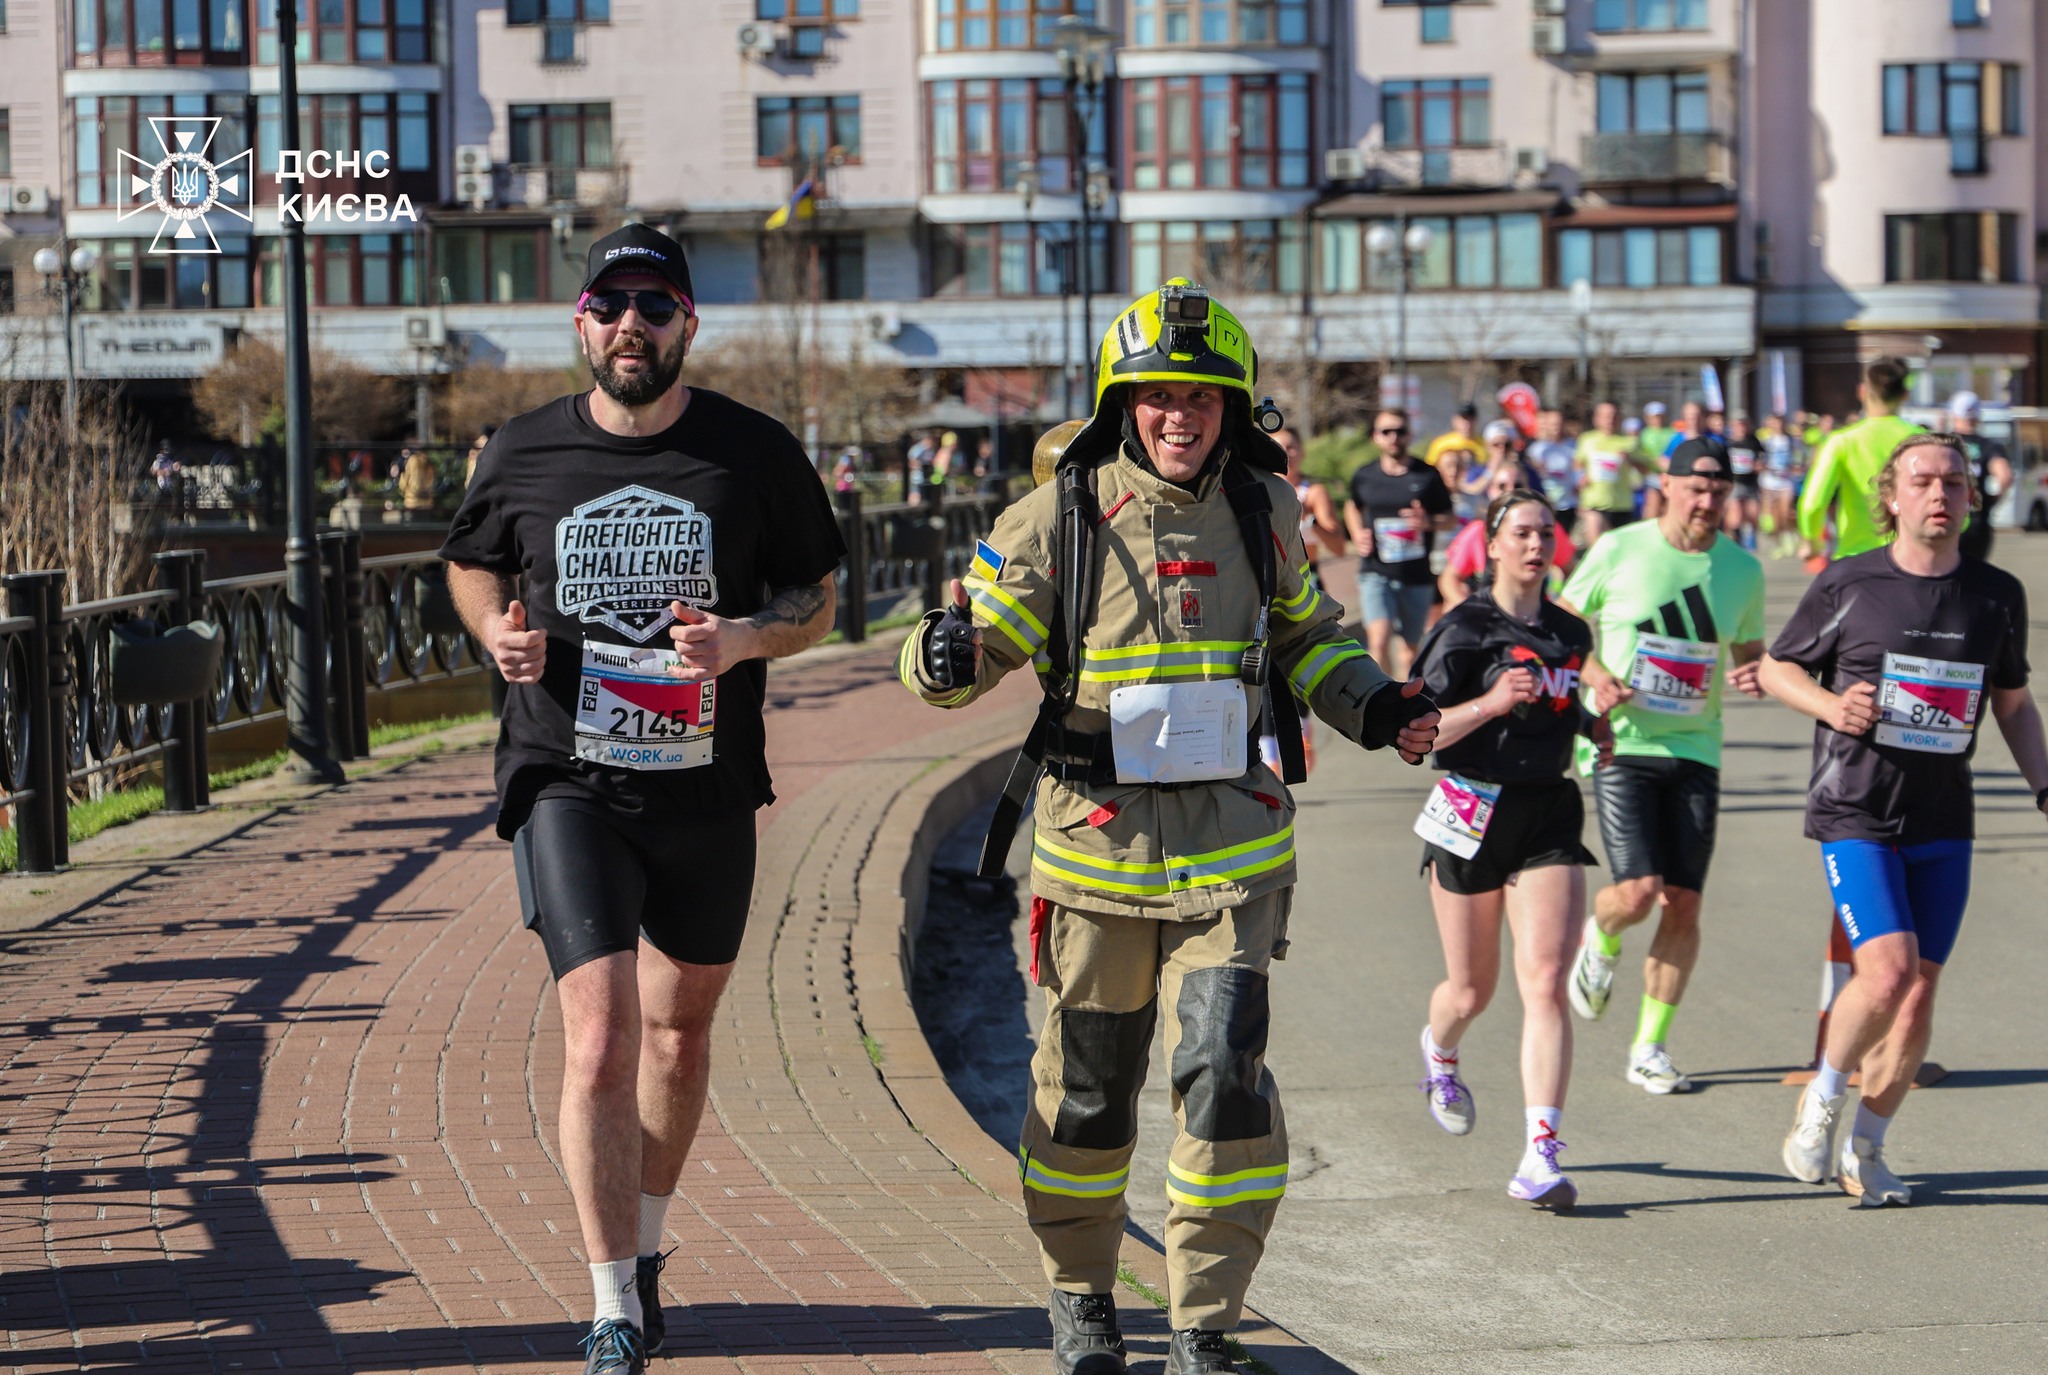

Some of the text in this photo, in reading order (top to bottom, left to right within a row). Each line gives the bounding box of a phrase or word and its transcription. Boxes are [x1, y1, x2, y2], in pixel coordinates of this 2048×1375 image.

[620, 246, 668, 261] Sporter
[1224, 330, 1239, 346] ГУ
[563, 520, 703, 549] FIREFIGHTER
[566, 549, 705, 579] CHALLENGE
[565, 580, 709, 605] CHAMPIONSHIP
[613, 599, 663, 609] SERIES
[594, 652, 628, 668] PUMA
[1946, 669, 1977, 679] NOVUS
[609, 707, 688, 737] 2145
[1910, 704, 1951, 727] 874
[1902, 732, 1953, 748] WORK.ua
[610, 746, 683, 763] WORK.ua
[1826, 853, 1860, 940] MIND BODY
